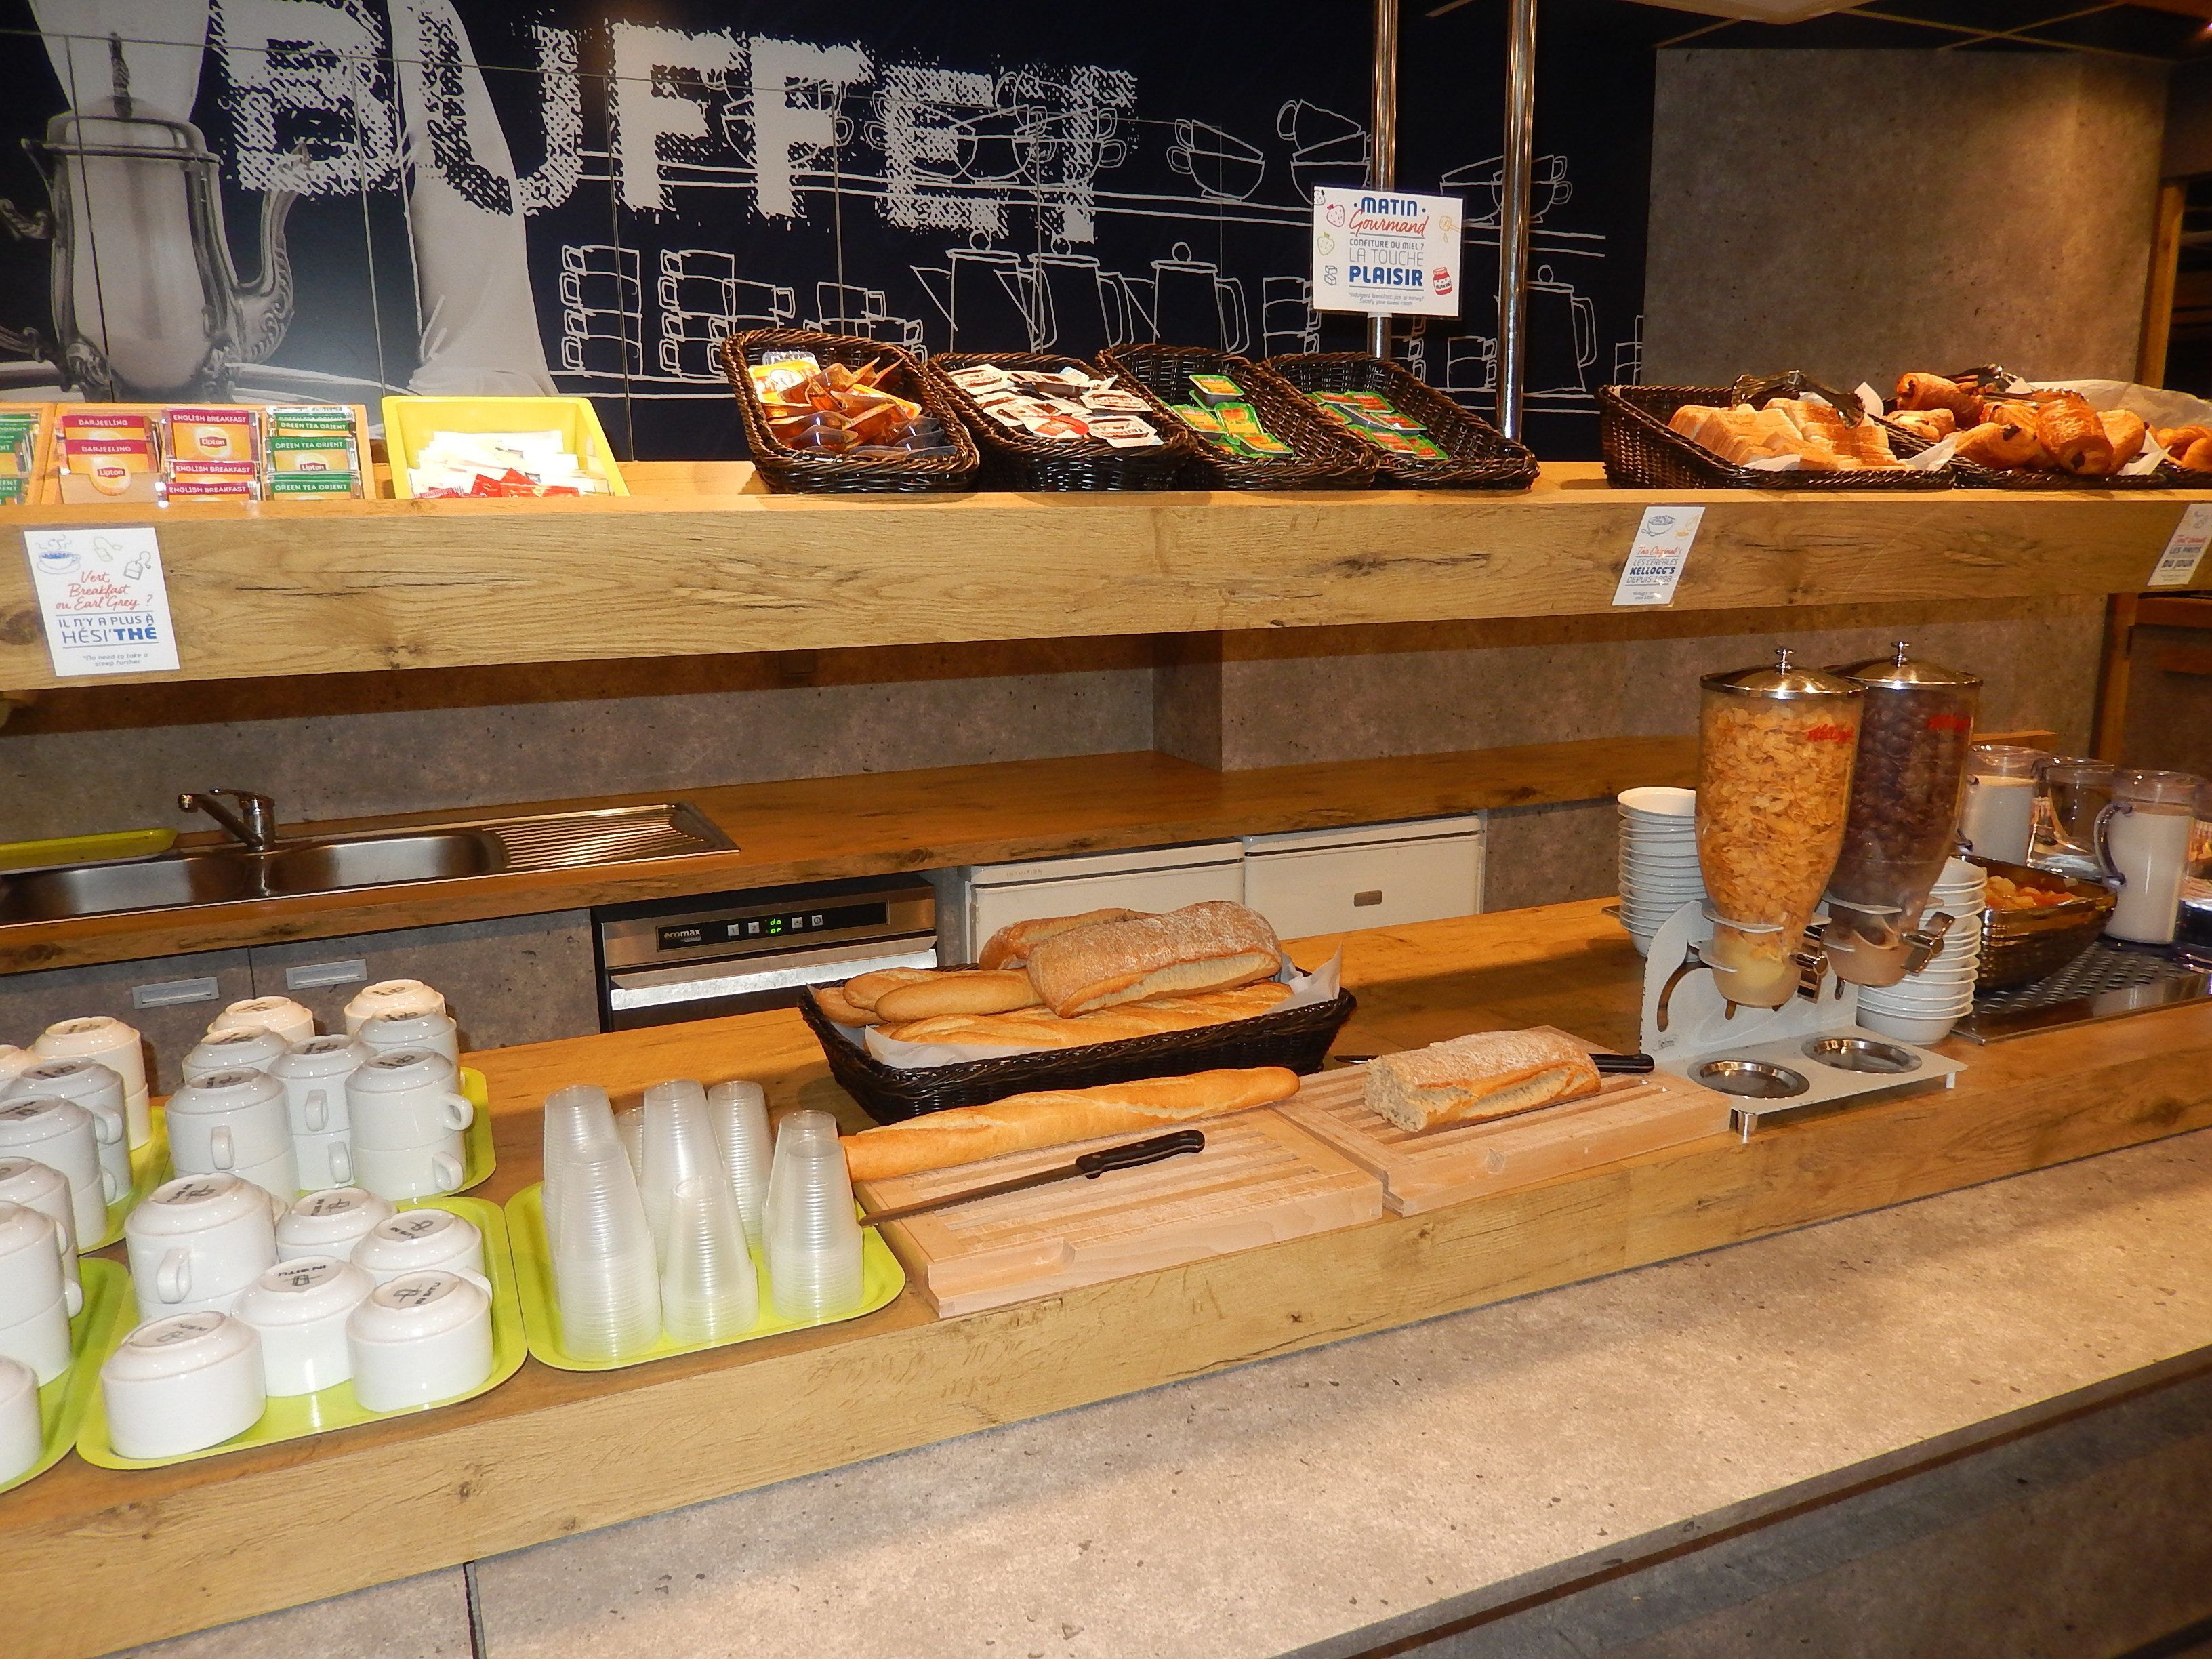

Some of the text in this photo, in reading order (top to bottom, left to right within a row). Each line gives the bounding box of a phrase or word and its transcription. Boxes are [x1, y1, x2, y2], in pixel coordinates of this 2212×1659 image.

[211, 0, 1139, 244] BUFFET
[1361, 197, 1418, 216] MATIN
[1349, 208, 1429, 237] Gourmand
[1349, 239, 1388, 248] CONFITURE
[1402, 242, 1418, 250] MIEL
[1349, 247, 1424, 267] LA TOUCHE
[1349, 265, 1423, 286] PLAISIR
[1630, 567, 1675, 575] KELLOGG'S
[68, 583, 131, 598] Breakfast
[74, 596, 104, 610] Earl
[106, 595, 140, 611] Grey
[146, 594, 153, 606] ?
[58, 619, 70, 628] IL
[98, 617, 106, 626] A
[110, 615, 142, 626] PLUS
[146, 613, 154, 623] À
[62, 624, 157, 644] HÉSI'THÉ
[664, 929, 701, 939] ecomax
